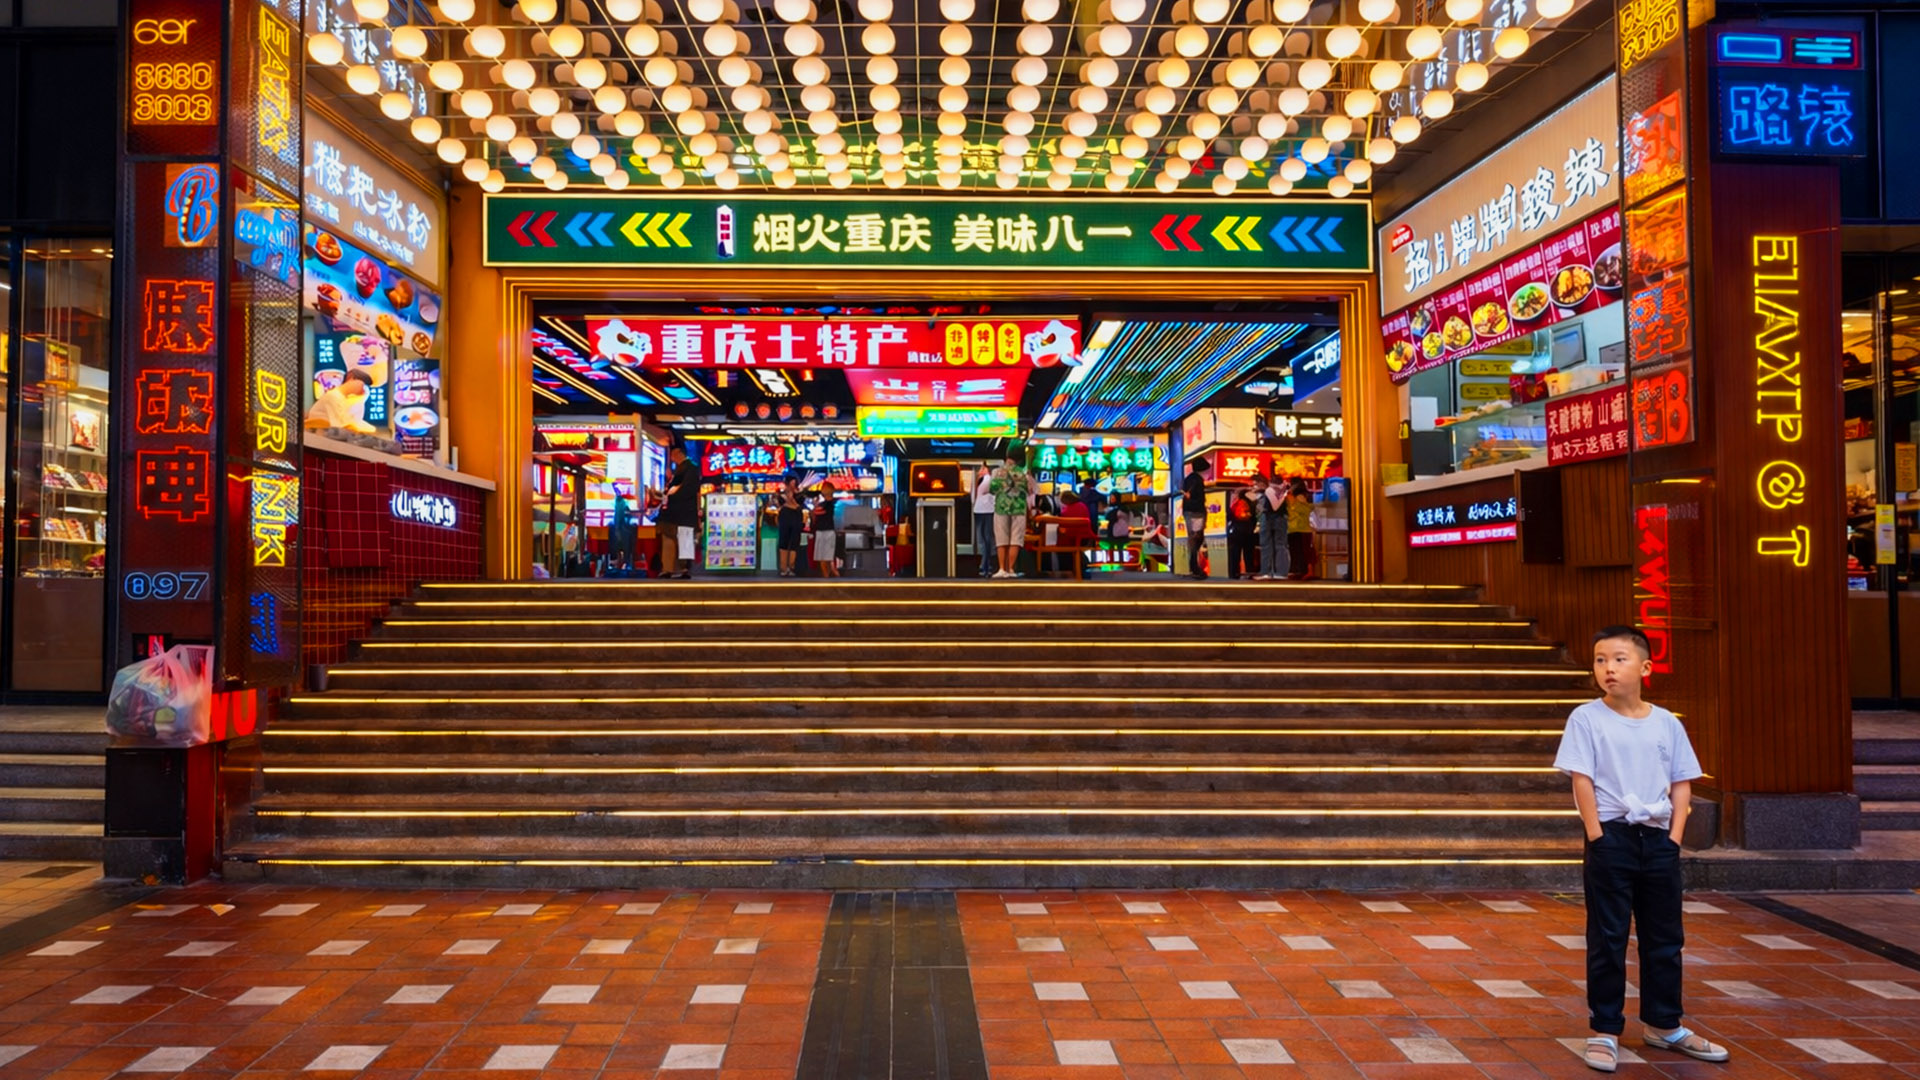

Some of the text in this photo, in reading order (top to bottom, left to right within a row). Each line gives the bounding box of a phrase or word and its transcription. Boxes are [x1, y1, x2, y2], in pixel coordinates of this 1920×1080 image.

[753, 213, 1132, 254] 烟火重庆 美味八一
[660, 323, 908, 365] 重庆土特产
[253, 369, 288, 567] DRNK
